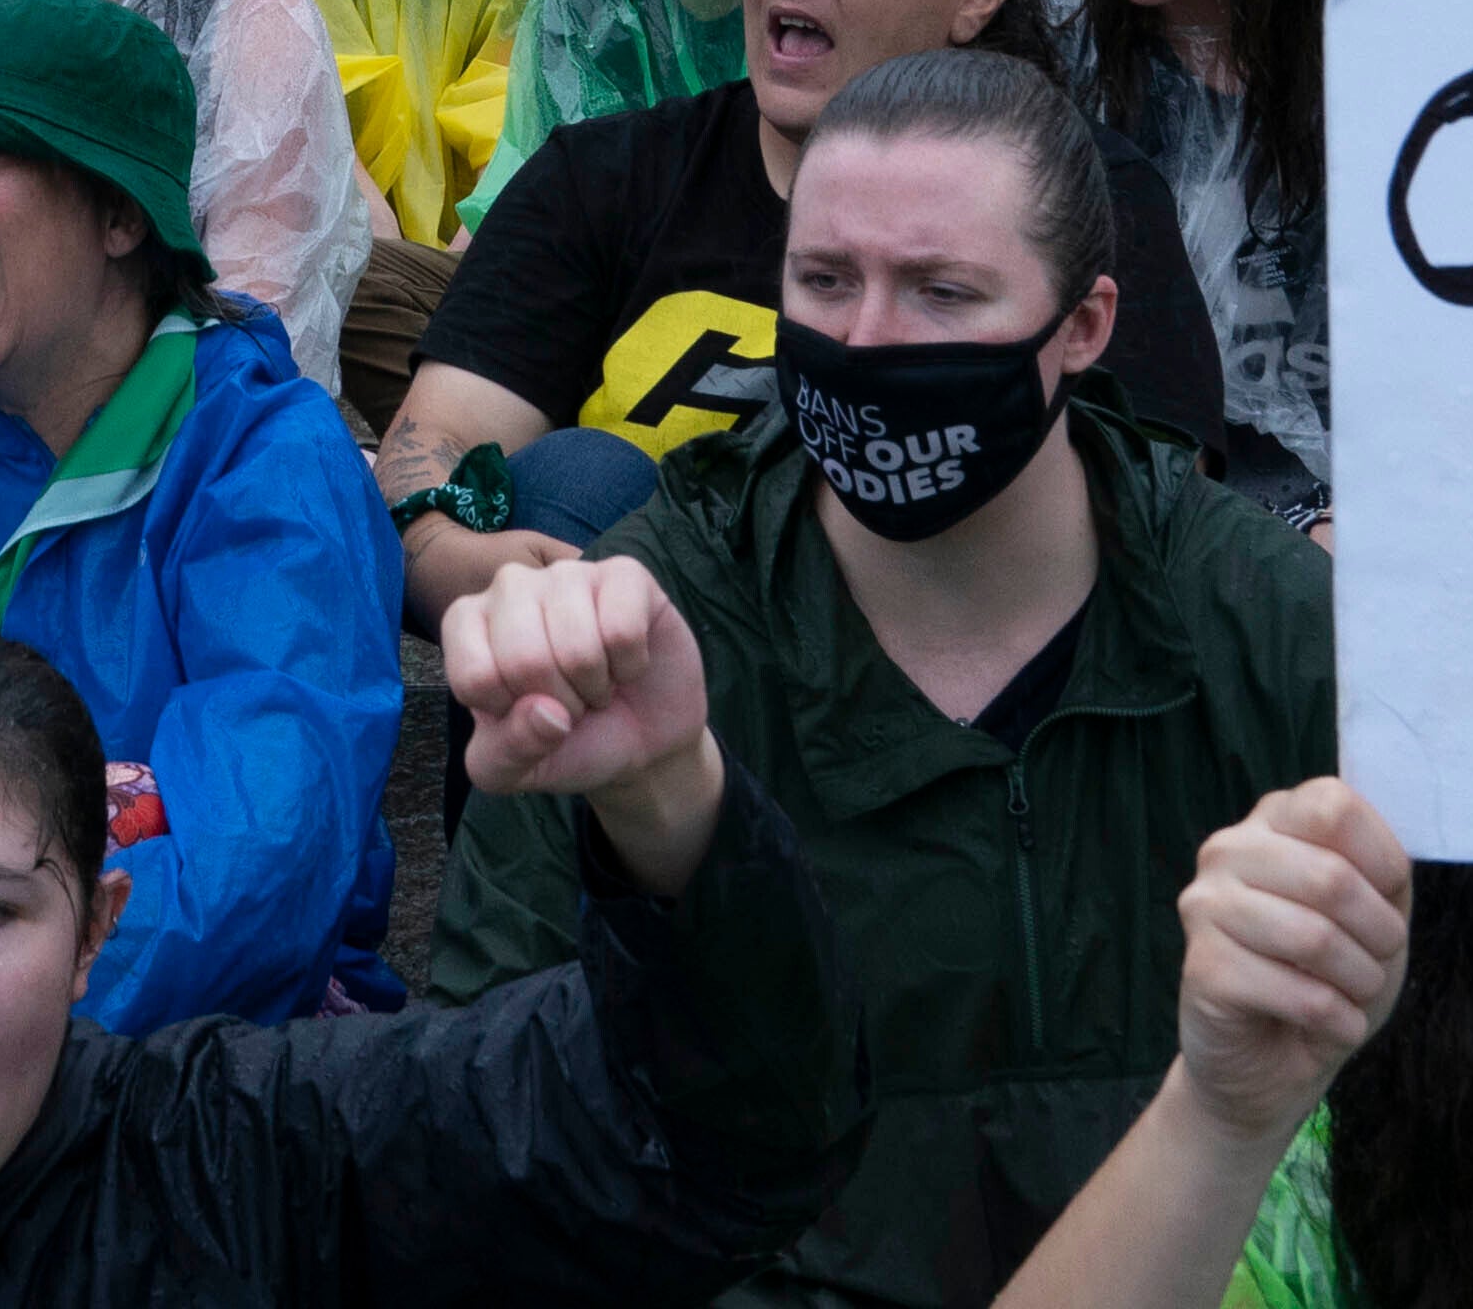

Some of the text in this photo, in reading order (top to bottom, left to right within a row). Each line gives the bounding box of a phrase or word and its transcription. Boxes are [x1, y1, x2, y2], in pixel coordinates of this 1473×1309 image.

[796, 373, 887, 438] BANS
[798, 411, 981, 472] OFF OUR
[805, 444, 966, 504] ODIES
